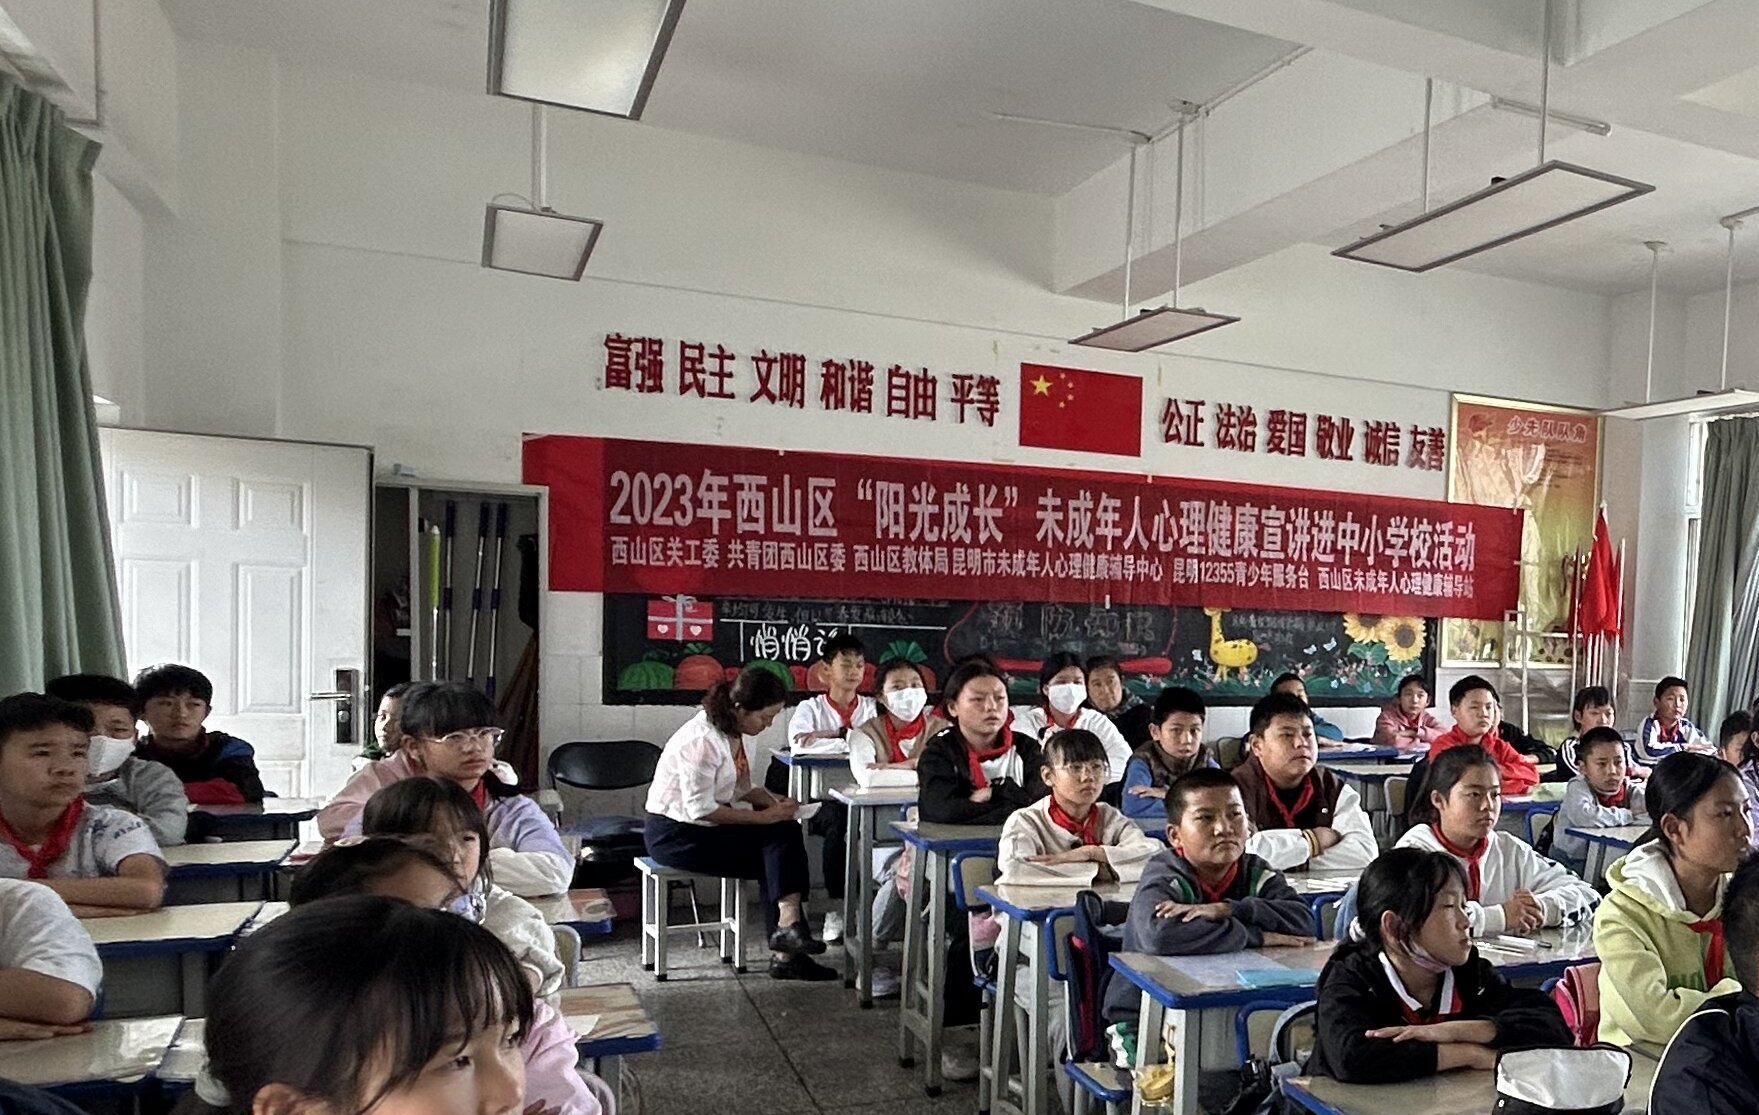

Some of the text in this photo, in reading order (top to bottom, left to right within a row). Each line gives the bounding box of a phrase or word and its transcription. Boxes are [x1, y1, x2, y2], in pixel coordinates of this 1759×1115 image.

[604, 333, 1001, 427] 富强 民主 文明 和谐 自由 平等
[1162, 397, 1445, 472] 公正 法治 爱国 敬业 诚信 友善
[609, 467, 838, 537] 2023年西山区
[1036, 487, 1476, 573] 未成年人心理健康宣讲进中小学校活动
[610, 536, 720, 568] 西山区关工委
[727, 541, 846, 573] 共青团西山区委
[1173, 558, 1309, 590] 昆明12355青少年服务台
